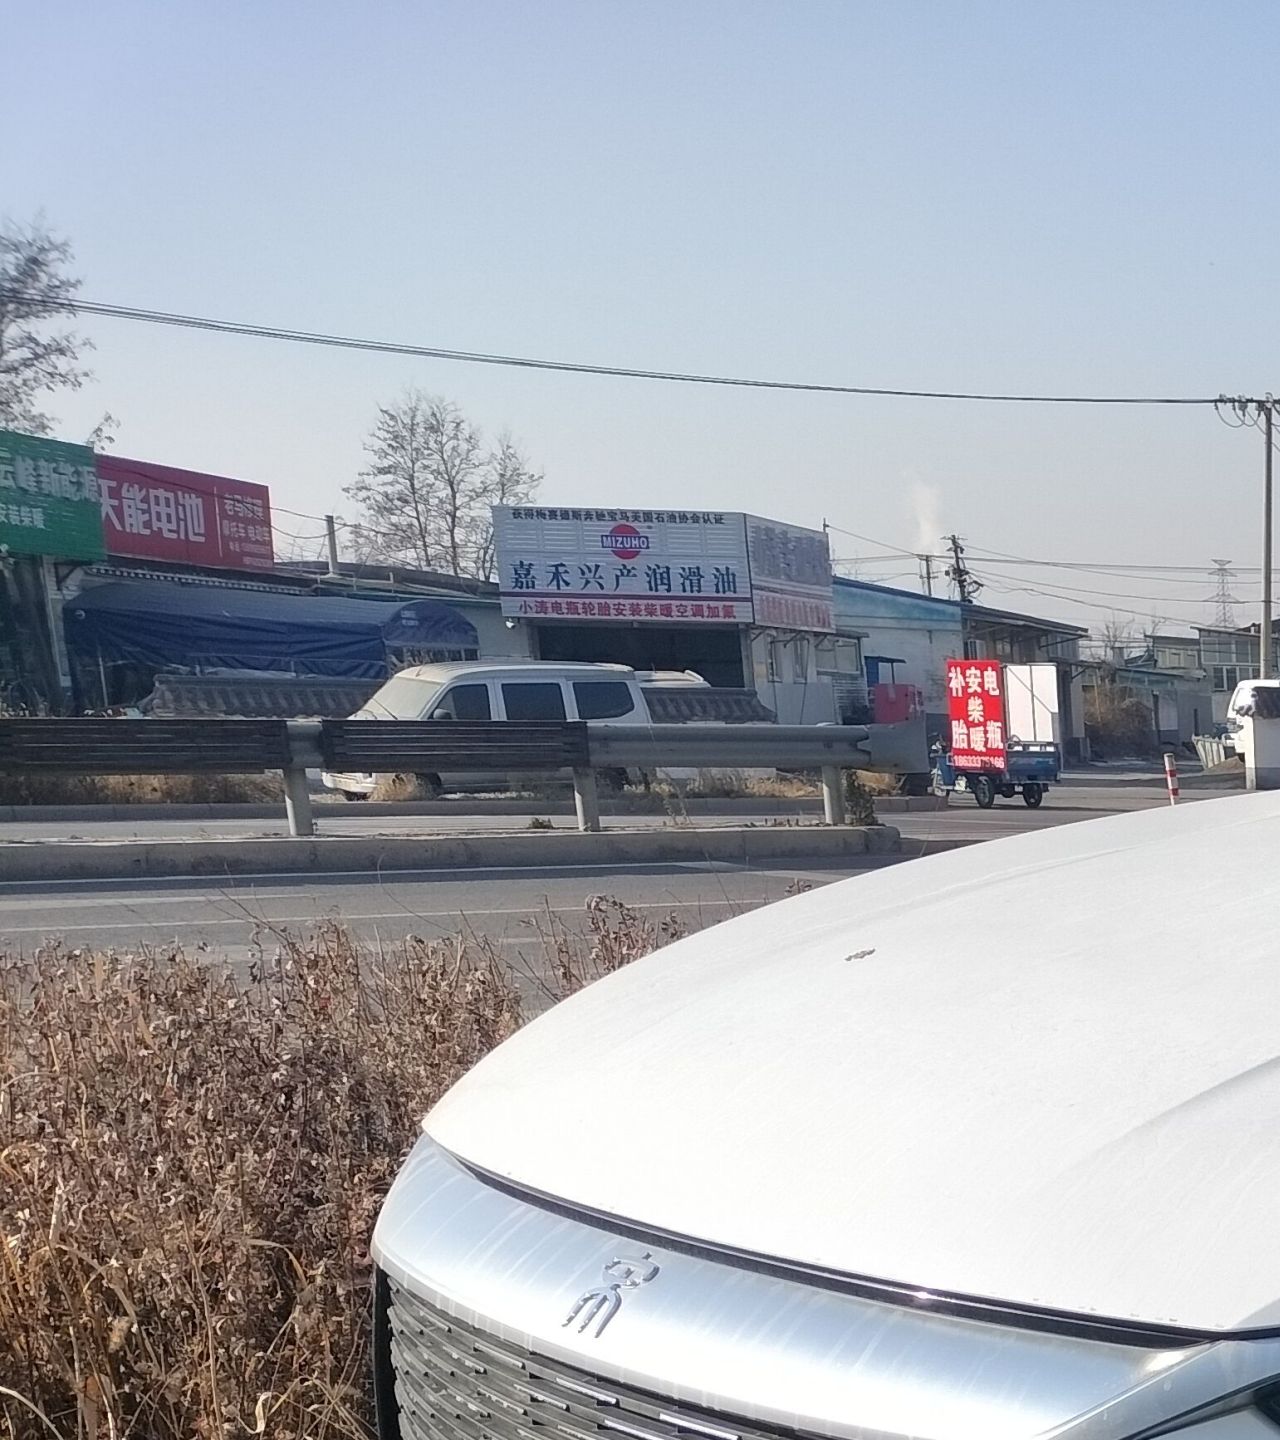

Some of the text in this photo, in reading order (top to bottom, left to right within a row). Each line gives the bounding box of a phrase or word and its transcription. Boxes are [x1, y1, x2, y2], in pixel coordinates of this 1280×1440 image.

[98, 478, 205, 543] 天能电池
[602, 536, 648, 548] MIZUHO
[509, 560, 737, 595] 嘉禾兴产润滑油
